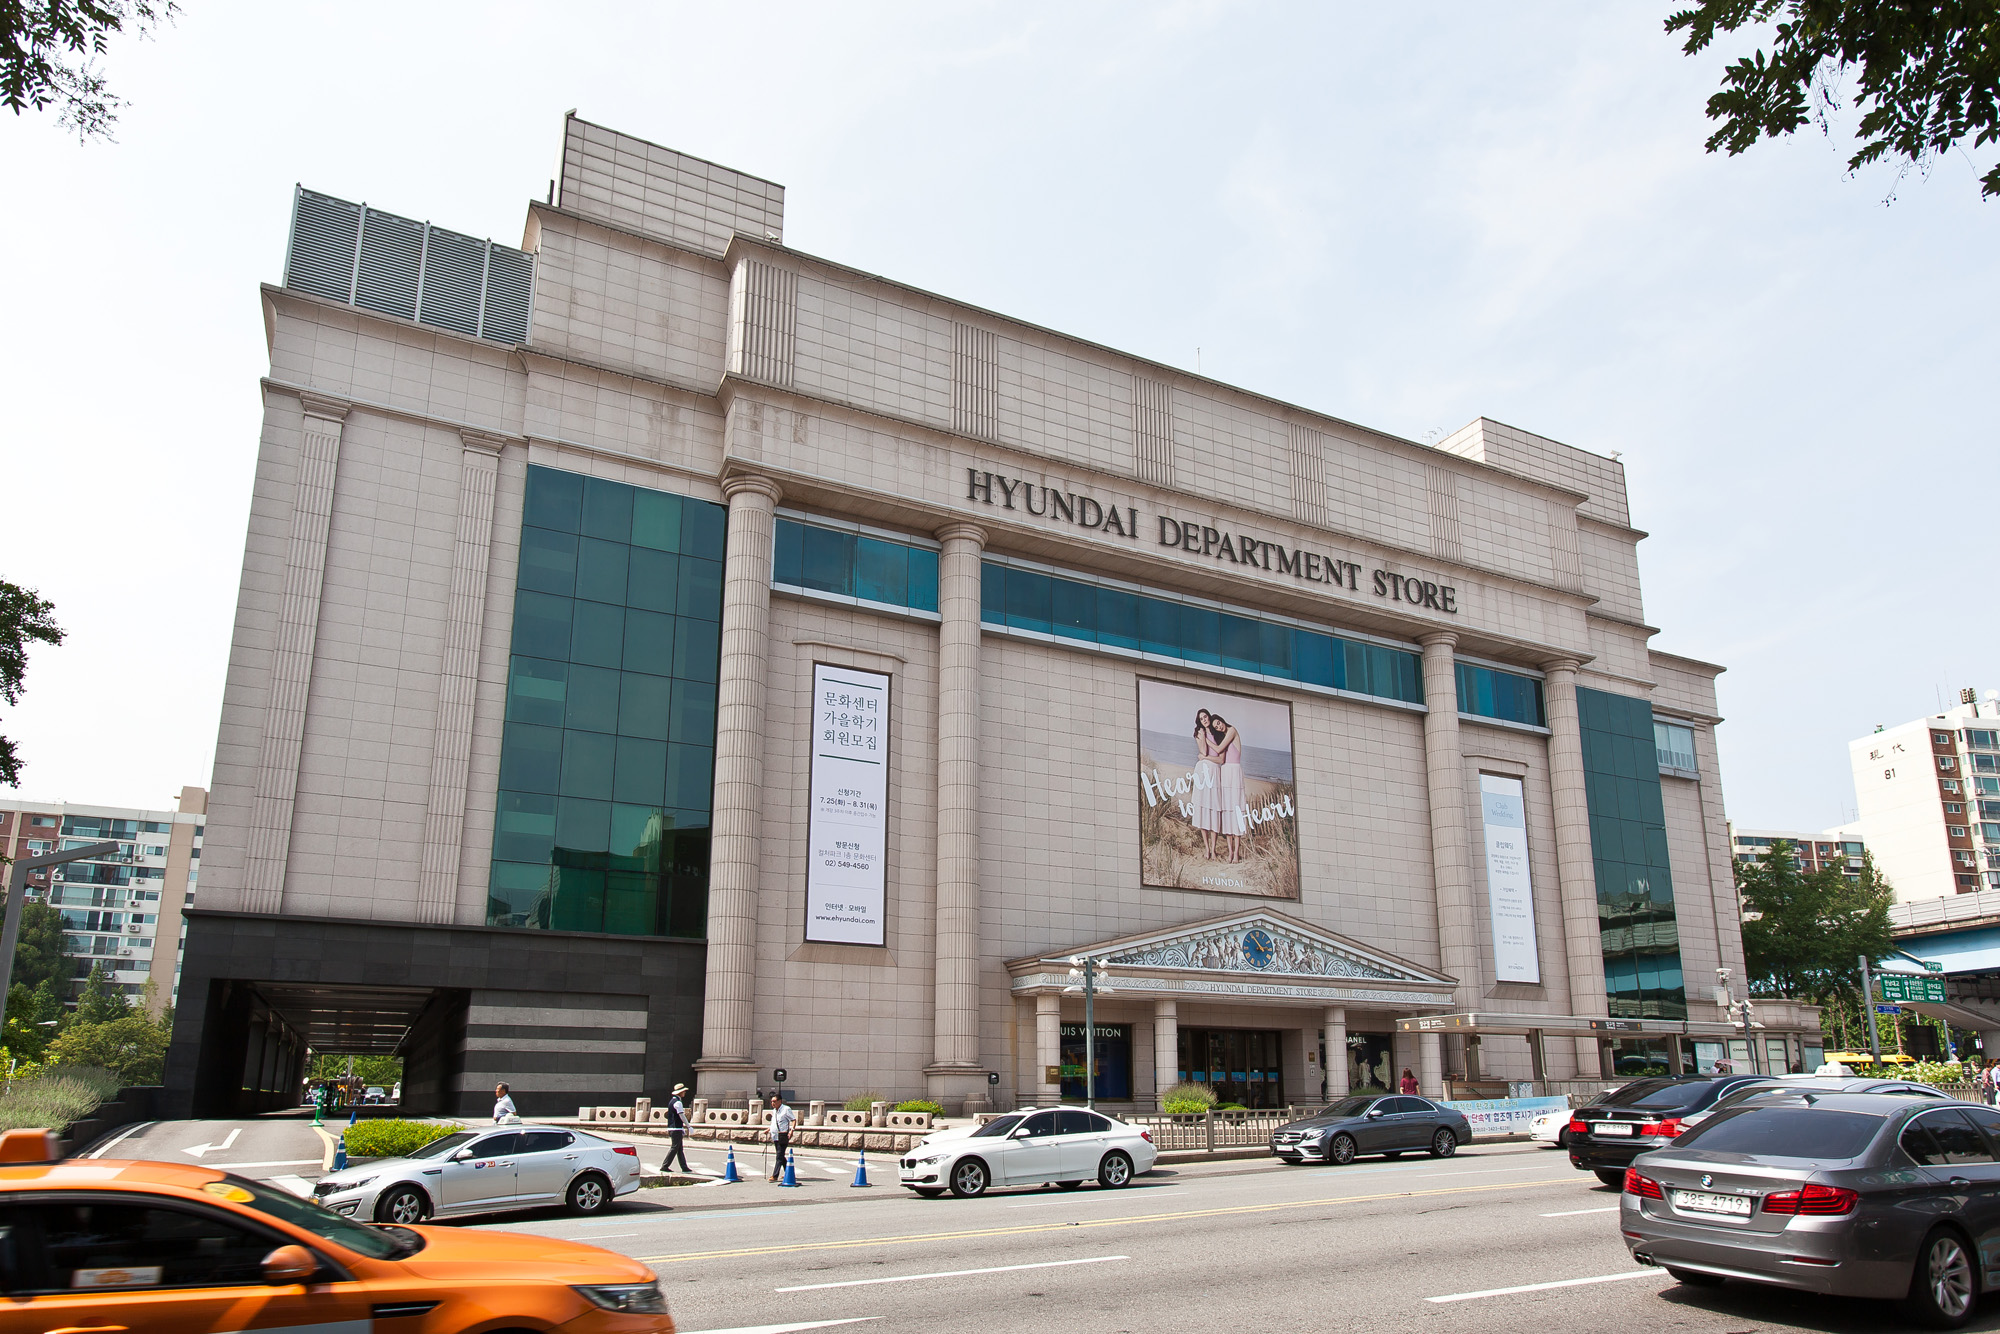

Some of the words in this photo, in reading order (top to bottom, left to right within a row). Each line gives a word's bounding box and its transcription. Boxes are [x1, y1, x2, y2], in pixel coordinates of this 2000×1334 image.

[966, 467, 1139, 539] HYUNDAI
[1158, 515, 1361, 591] DEPARTMENT
[1373, 569, 1458, 614] STORE
[823, 691, 878, 713] 문화센터
[823, 710, 878, 732] 가을학기
[823, 729, 877, 750] 회원모집
[1869, 743, 1905, 761] 現代
[1884, 767, 1896, 780] 81
[1141, 763, 1215, 808] Heart
[837, 788, 862, 798] 신청기간
[1177, 799, 1195, 819] to
[1234, 795, 1295, 834] Heart
[835, 841, 860, 851] 방문신청
[853, 853, 877, 862] 문화센터
[824, 859, 837, 867] 02)
[837, 861, 870, 871] 549-4560
[1202, 876, 1244, 888] HYUNDAI
[824, 902, 844, 911] 인터넷
[848, 904, 867, 913] 모바일
[815, 914, 876, 925] www.ehyundai.com
[1210, 983, 1245, 994] HYUNDAI
[1247, 985, 1293, 996] DEPARTMENT
[1296, 987, 1318, 997] STORE
[1060, 1026, 1076, 1036] UIS
[1079, 1027, 1121, 1037] VITTON
[1345, 1036, 1367, 1044] ANEL
[1471, 1112, 1491, 1123] 단속에
[1493, 1111, 1513, 1122] 협조해
[1514, 1110, 1534, 1121] 주시기
[1710, 1195, 1743, 1210] 4719
